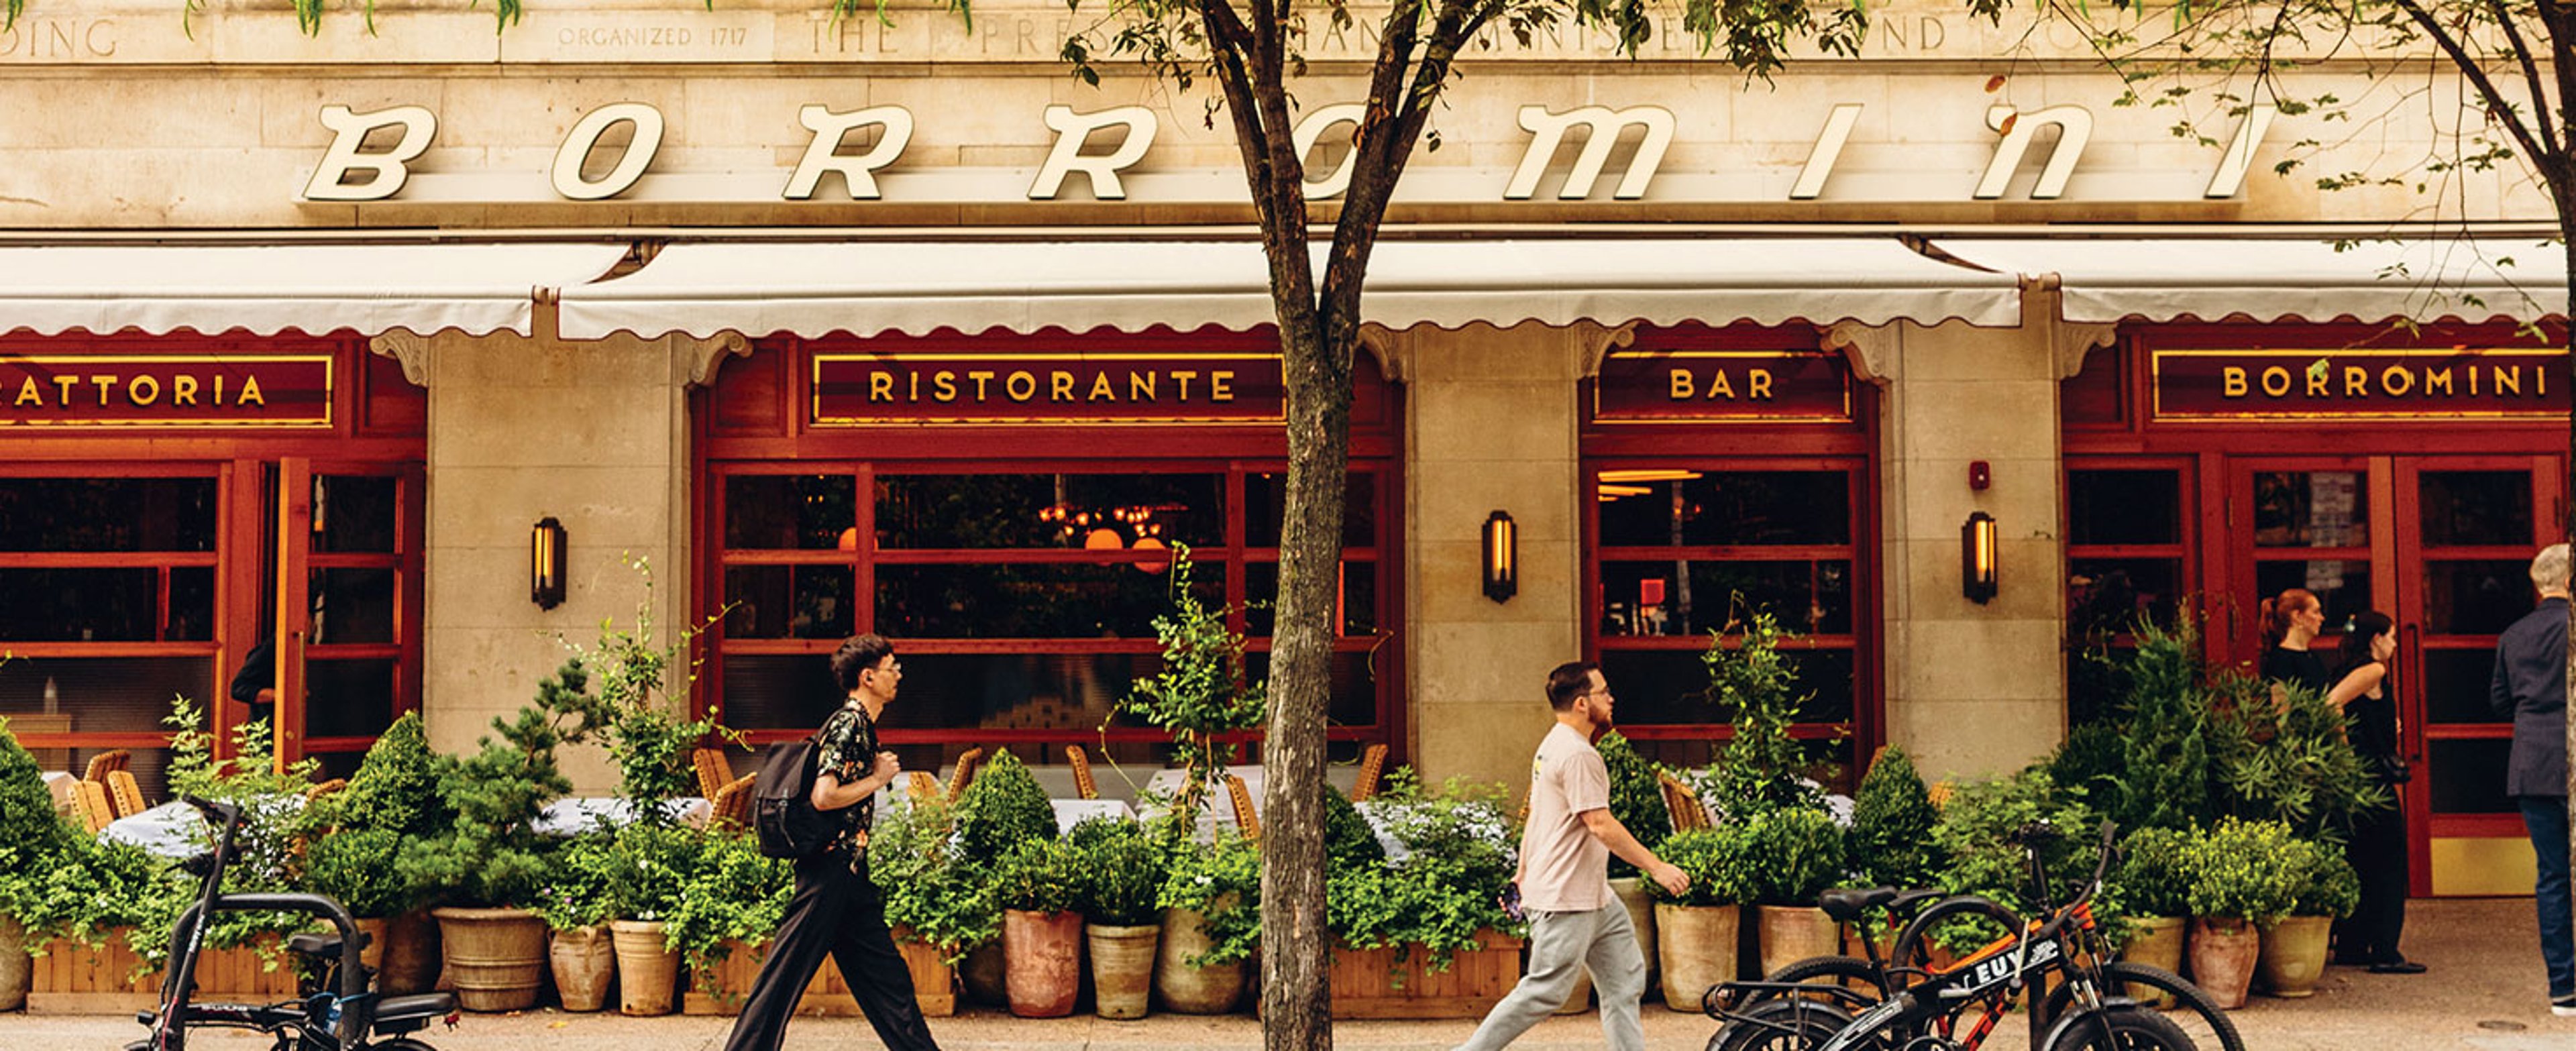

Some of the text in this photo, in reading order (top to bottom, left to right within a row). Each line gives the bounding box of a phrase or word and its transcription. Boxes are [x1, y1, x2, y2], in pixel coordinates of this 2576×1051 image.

[558, 27, 747, 46] ORGANIZED 1717
[805, 19, 898, 53] THE
[0, 374, 265, 406] ATTORIA
[869, 370, 1235, 401] RISTORANTE
[1670, 368, 1774, 400] BAR
[2224, 366, 2546, 397] BORROMINI
